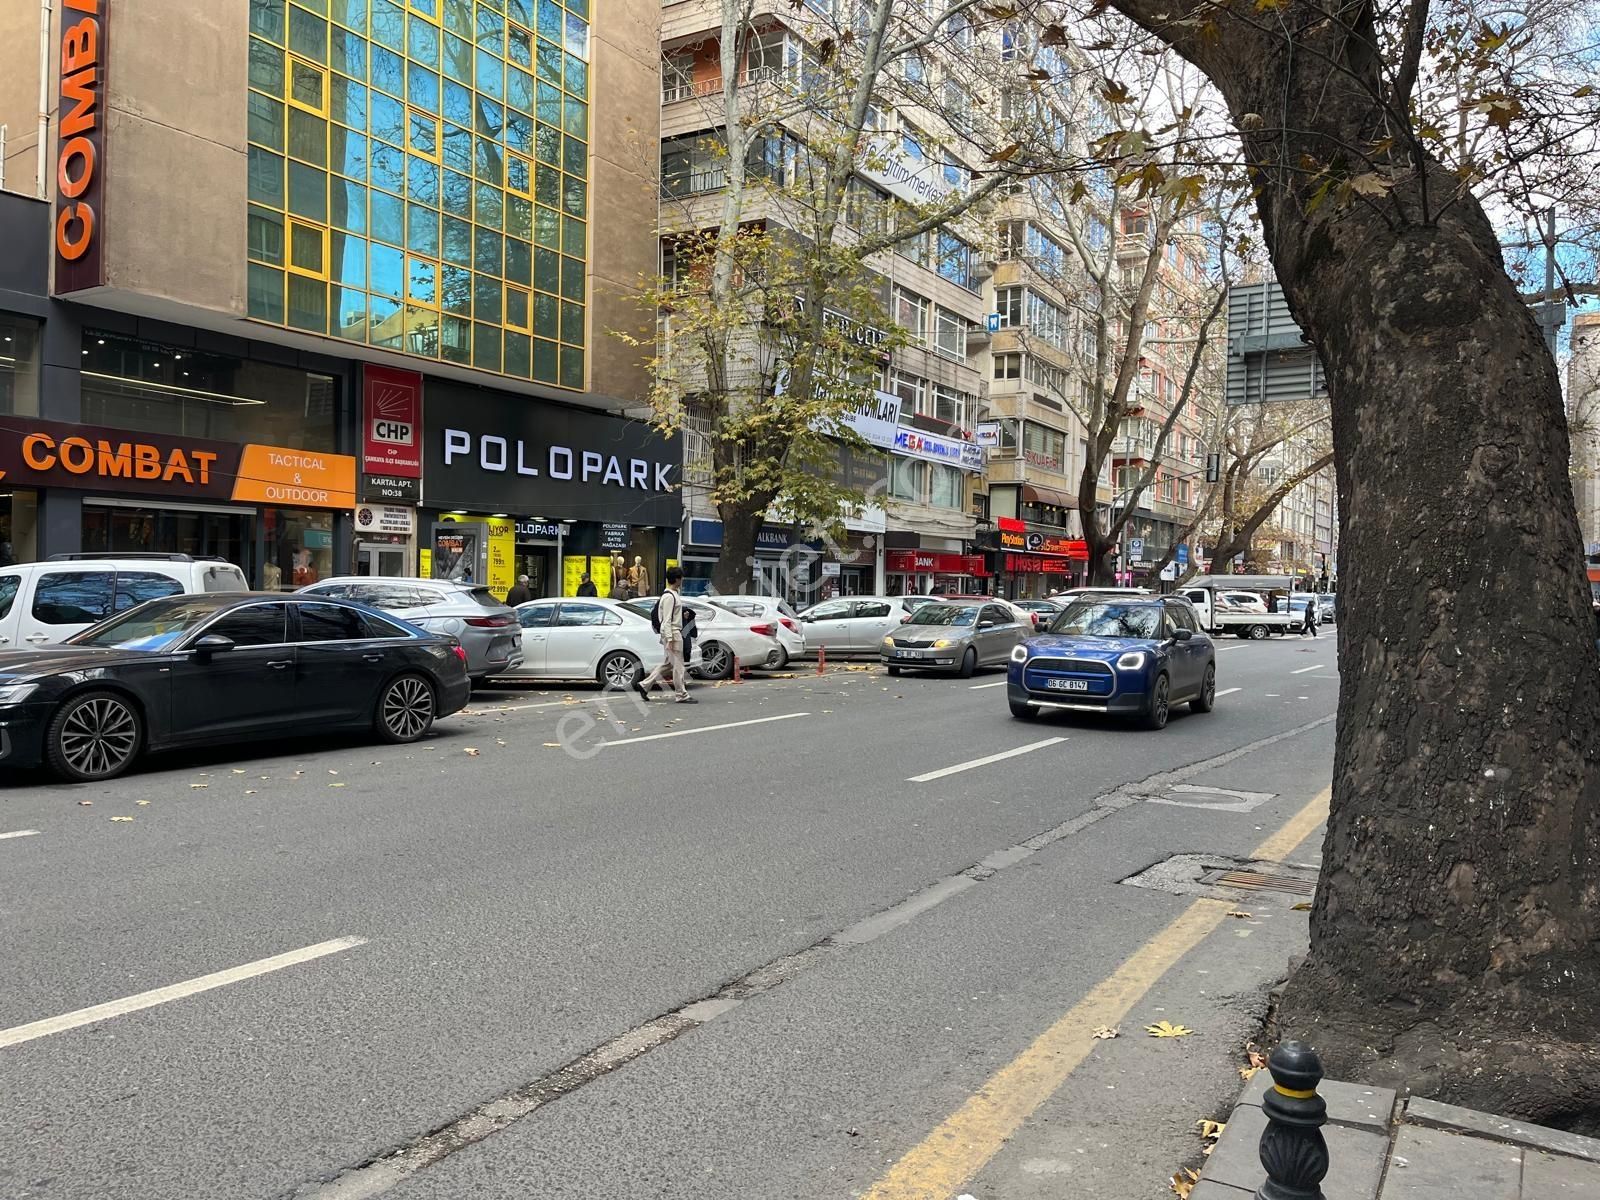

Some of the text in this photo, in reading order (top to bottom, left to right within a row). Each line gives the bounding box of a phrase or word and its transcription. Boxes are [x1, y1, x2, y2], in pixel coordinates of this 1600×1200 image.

[57, 0, 99, 260] COMB
[376, 422, 409, 440] CHP
[894, 432, 924, 452] MEGA
[22, 432, 217, 484] COMBAT
[268, 453, 326, 471] TACTICAL
[444, 428, 673, 493] POLOPARK
[294, 473, 302, 485] &
[371, 478, 413, 488] KARTAL APT.
[266, 486, 328, 503] OUTDOOR
[382, 489, 402, 497] NO:38
[515, 523, 559, 536] OLOPARK
[757, 531, 788, 544] ALKBANK
[1001, 532, 1025, 547] PlayStation
[914, 557, 933, 567] BANK
[1048, 679, 1057, 688] 06
